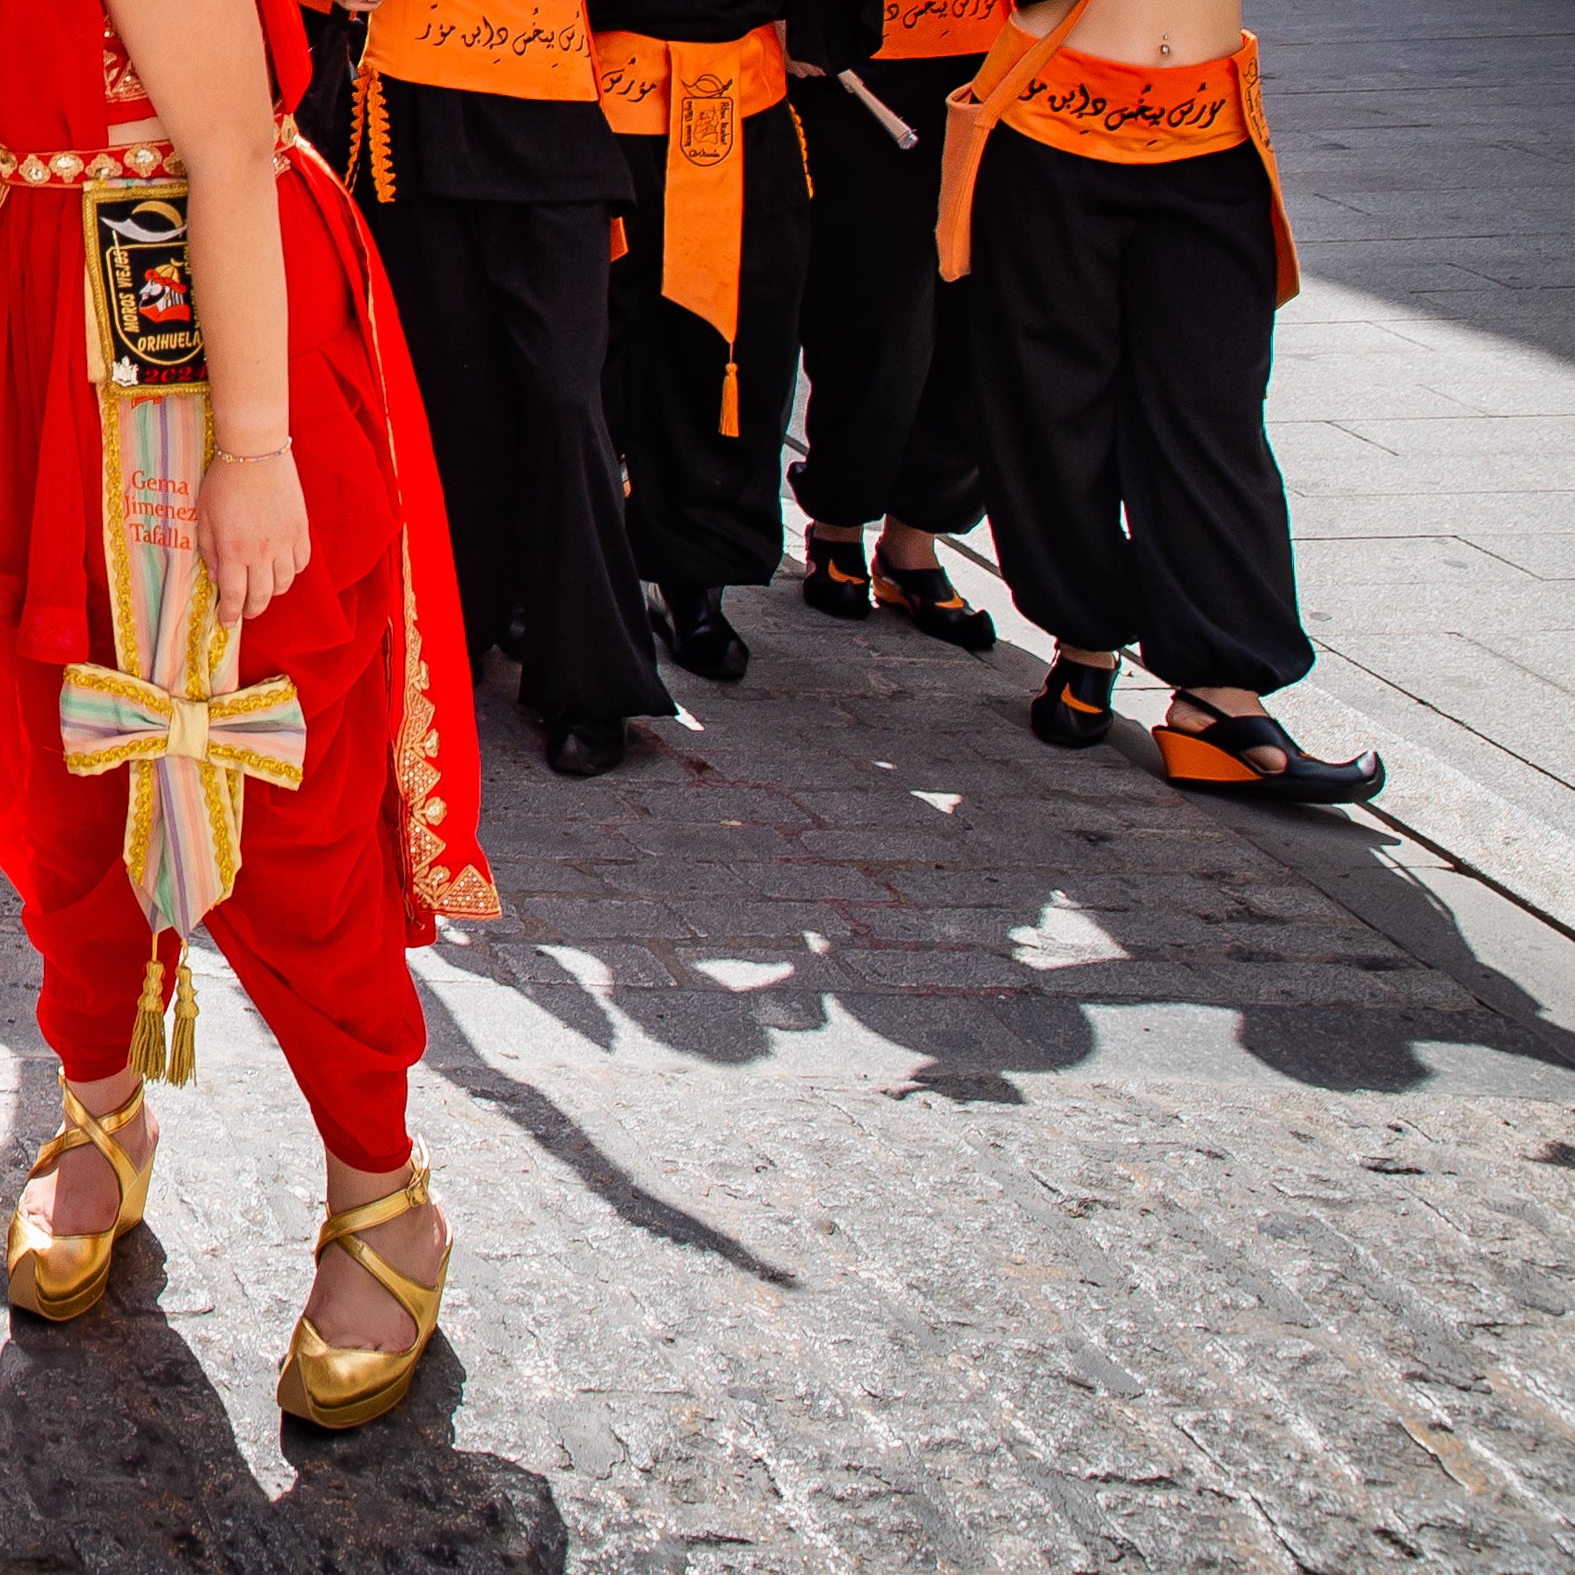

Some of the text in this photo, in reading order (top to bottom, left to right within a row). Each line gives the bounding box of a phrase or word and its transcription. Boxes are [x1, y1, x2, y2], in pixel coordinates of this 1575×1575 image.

[119, 293, 140, 333] MOROS
[137, 330, 202, 354] ORIHUELA
[131, 469, 189, 496] Gema
[124, 494, 198, 521] Jimenez
[129, 523, 191, 550] Tafalla
